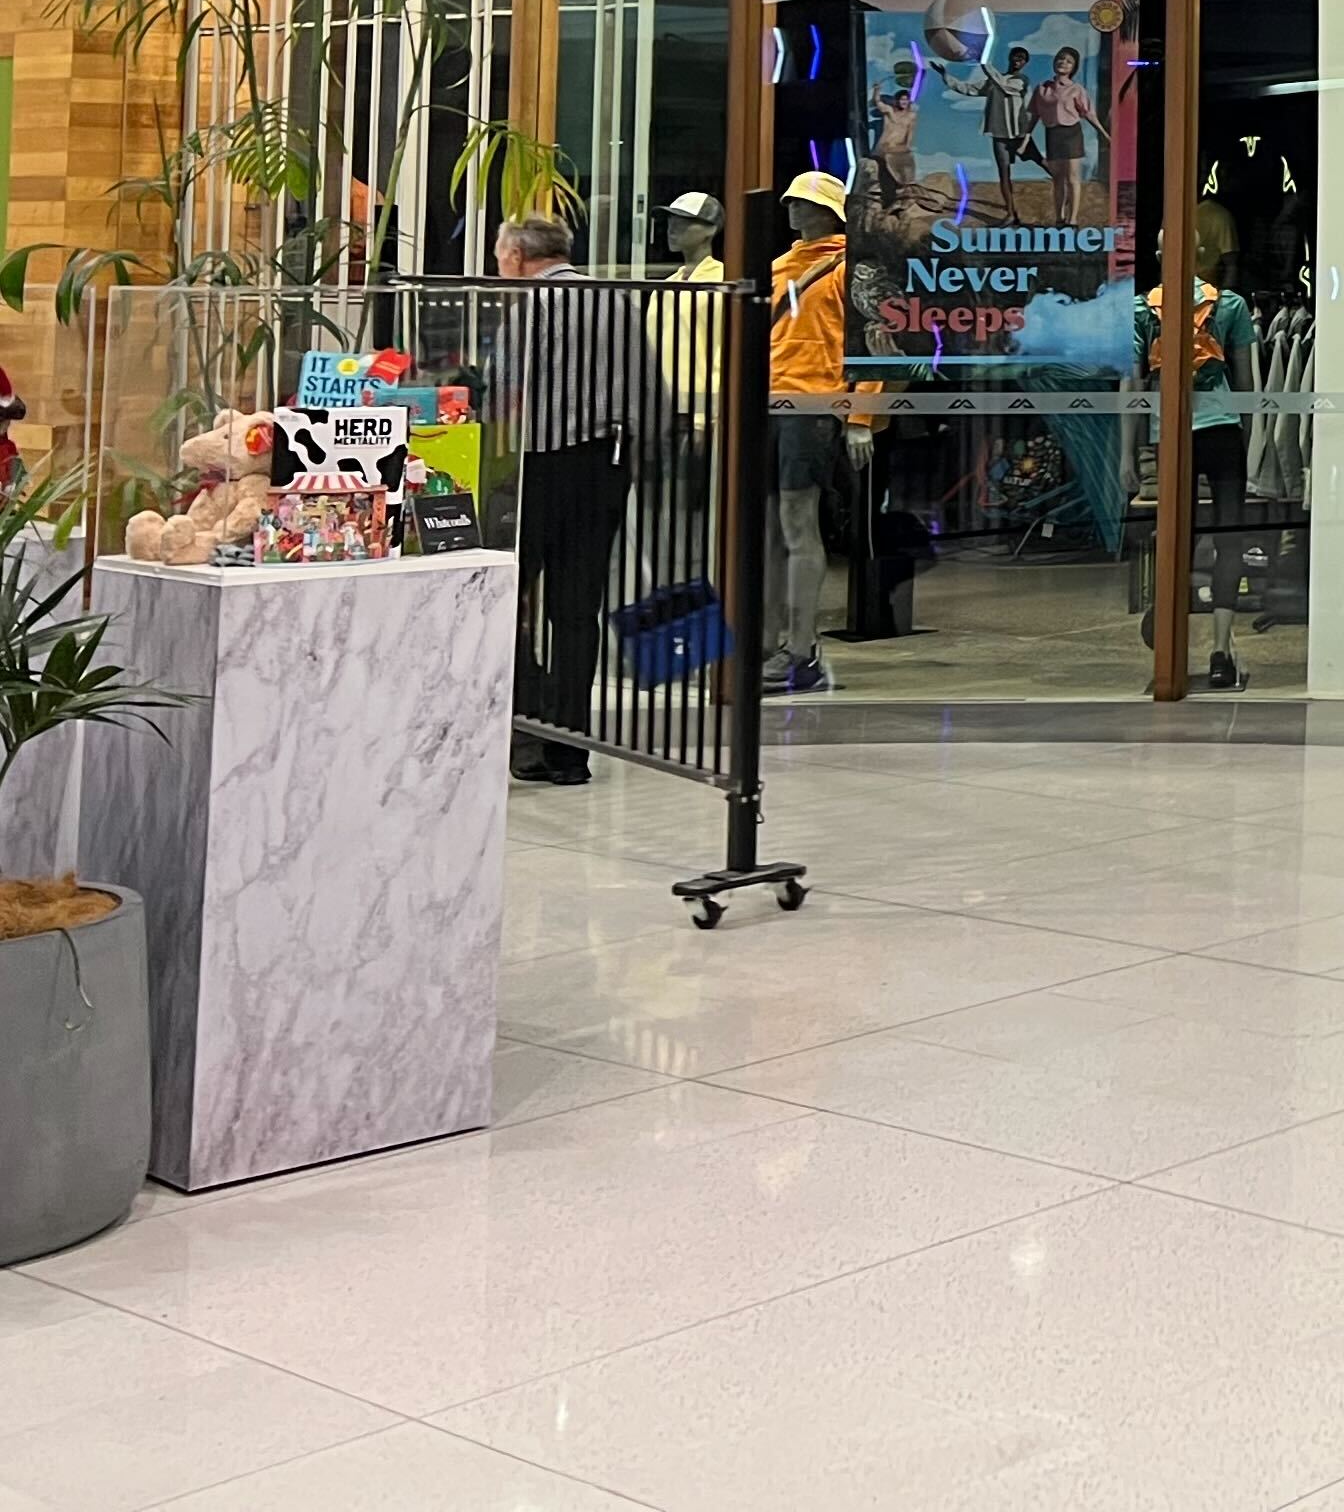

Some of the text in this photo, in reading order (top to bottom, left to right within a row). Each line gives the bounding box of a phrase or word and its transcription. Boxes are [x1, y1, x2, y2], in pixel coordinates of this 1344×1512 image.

[930, 217, 1125, 254] Summer
[905, 257, 1038, 293] Never
[879, 295, 1026, 342] Sleeps
[312, 356, 331, 373] IT
[305, 375, 380, 396] STARTS
[335, 418, 393, 437] HERD
[334, 437, 391, 446] MENTALITY
